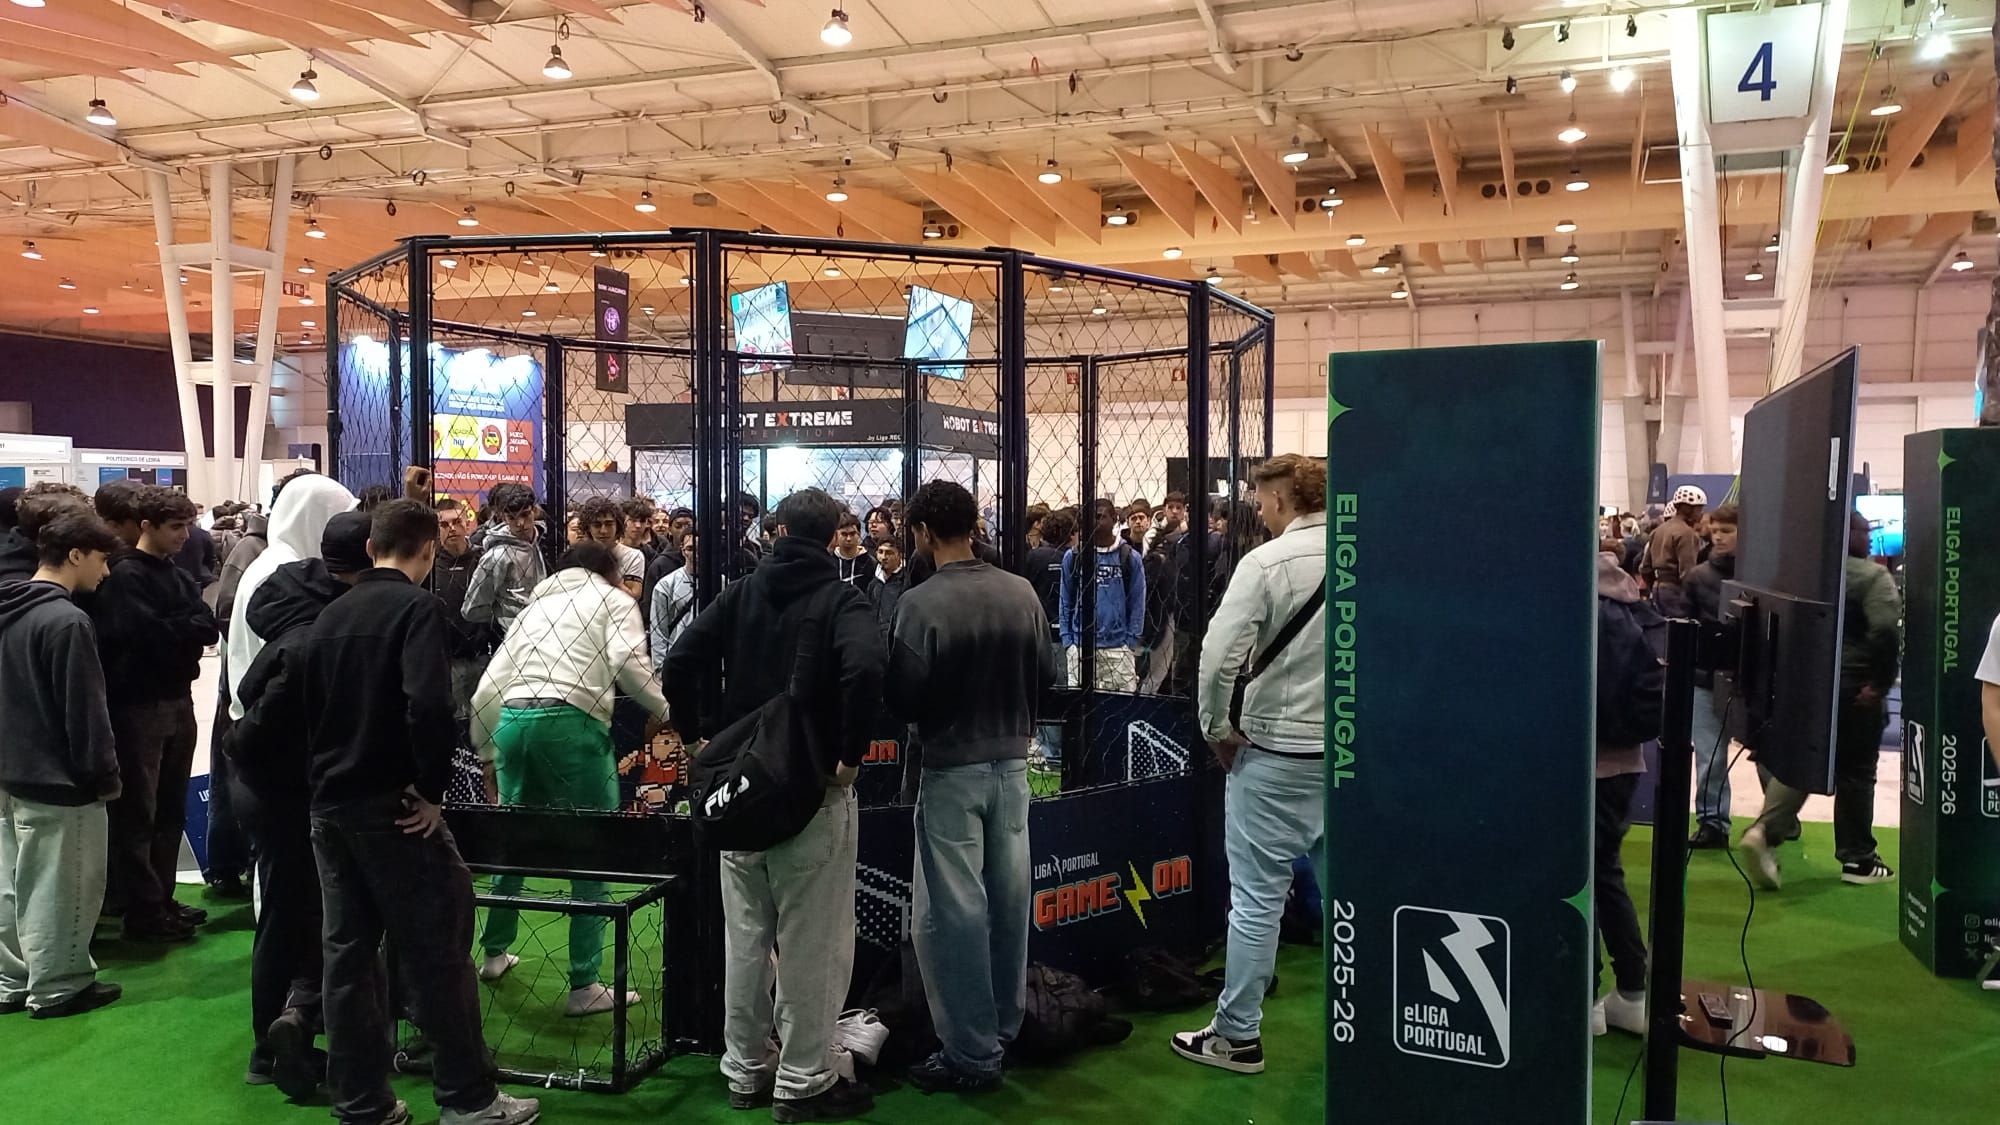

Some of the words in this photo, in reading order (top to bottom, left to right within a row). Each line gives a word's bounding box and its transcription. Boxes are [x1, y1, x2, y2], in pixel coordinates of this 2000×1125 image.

[1737, 42, 1777, 102] 4
[764, 410, 853, 427] EXTREME
[942, 415, 970, 432] ROBOT
[973, 420, 1002, 436] EXTRE
[1335, 494, 1358, 592] ELIGA
[1945, 507, 1961, 563] ELIGA
[1943, 567, 1960, 673] PORTUGAL
[1333, 601, 1357, 788] PORTUGAL
[1941, 734, 1957, 815] 2025-26
[1033, 872, 1121, 931] GAME
[1152, 855, 1192, 899] ON
[1034, 863, 1051, 880] LIGA
[1062, 852, 1099, 873] PORTUGAL
[1333, 899, 1355, 1043] 2025-26
[1404, 1003, 1449, 1027] eLIGA
[1404, 1024, 1486, 1056] PORTUGAL
